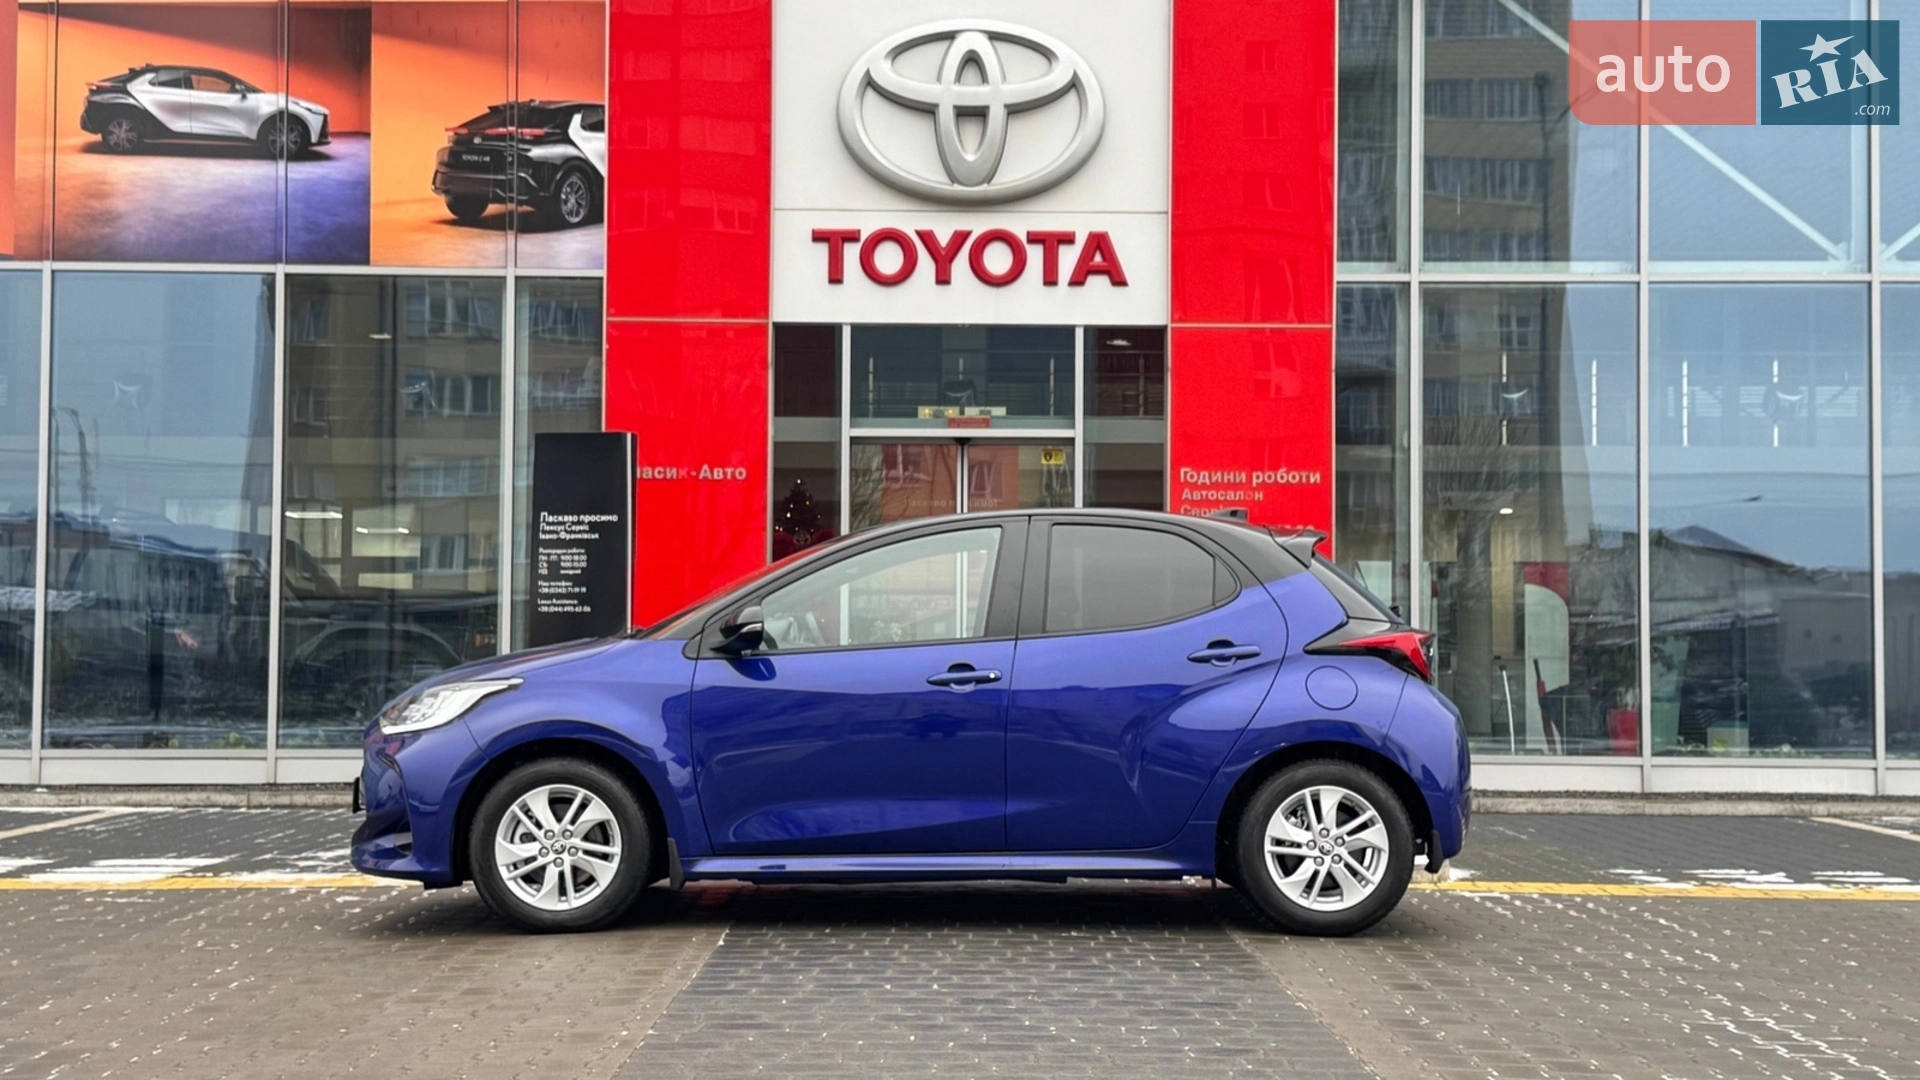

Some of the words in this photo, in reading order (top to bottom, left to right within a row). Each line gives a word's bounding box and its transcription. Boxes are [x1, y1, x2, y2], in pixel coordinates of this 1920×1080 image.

[811, 227, 1129, 288] TOYOTA
[1180, 467, 1246, 486] Години
[1252, 467, 1321, 487] роботи
